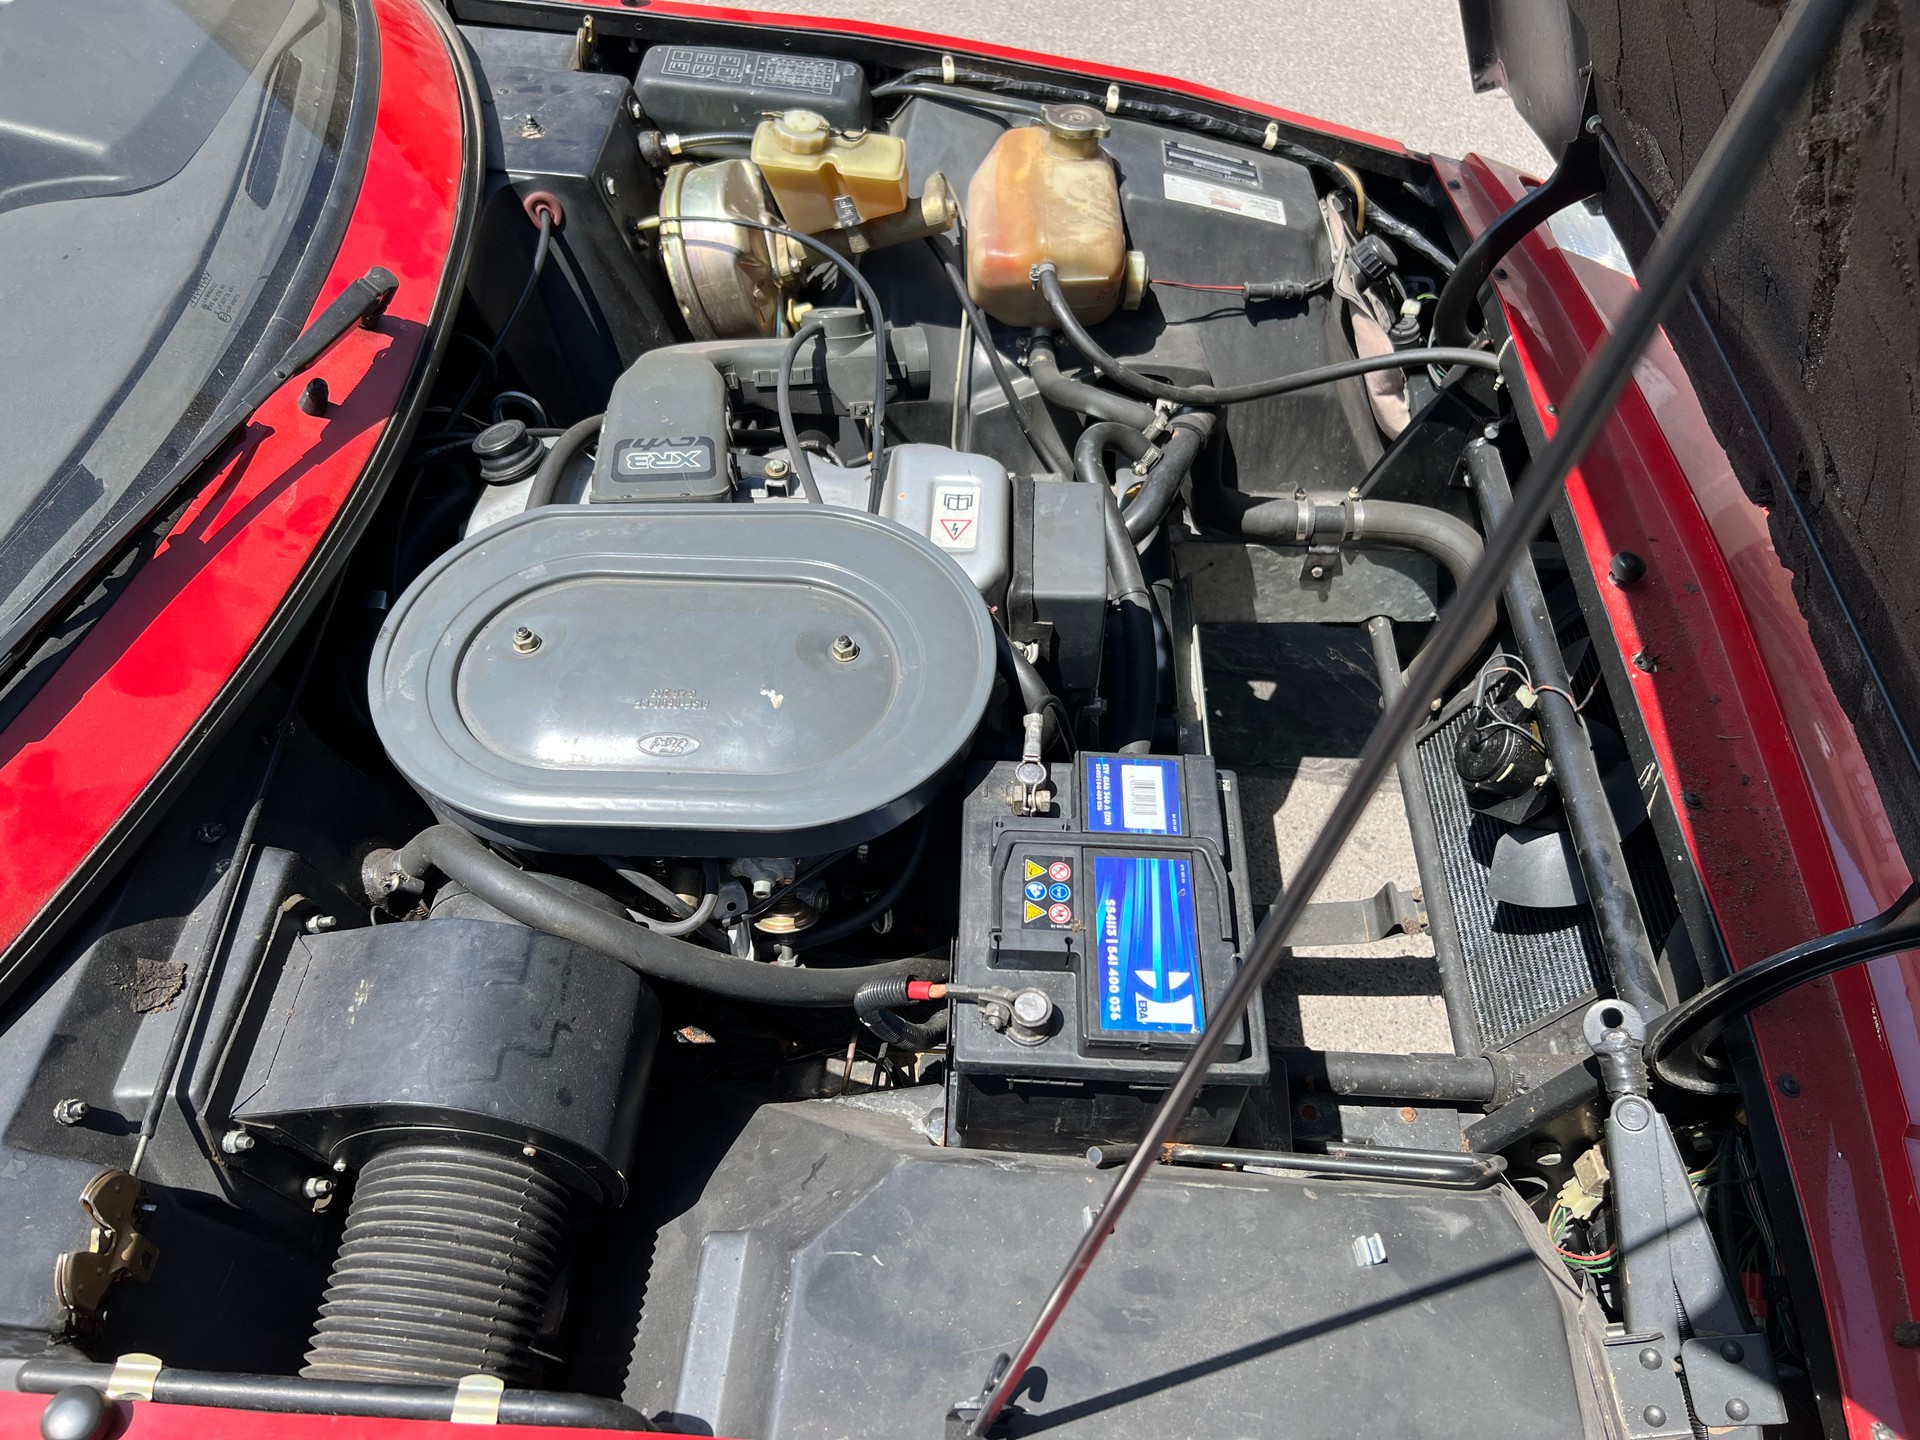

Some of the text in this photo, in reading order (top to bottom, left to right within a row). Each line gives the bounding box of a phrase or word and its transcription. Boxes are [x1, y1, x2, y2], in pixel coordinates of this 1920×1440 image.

[626, 450, 702, 470] XR3
[649, 737, 689, 753] Ford
[1103, 791, 1111, 804] 360
[1105, 899, 1117, 936] S54113
[1107, 945, 1119, 966] 541
[1108, 967, 1120, 994] 400
[1109, 996, 1121, 1021] 036
[1138, 1000, 1148, 1019] ERA
